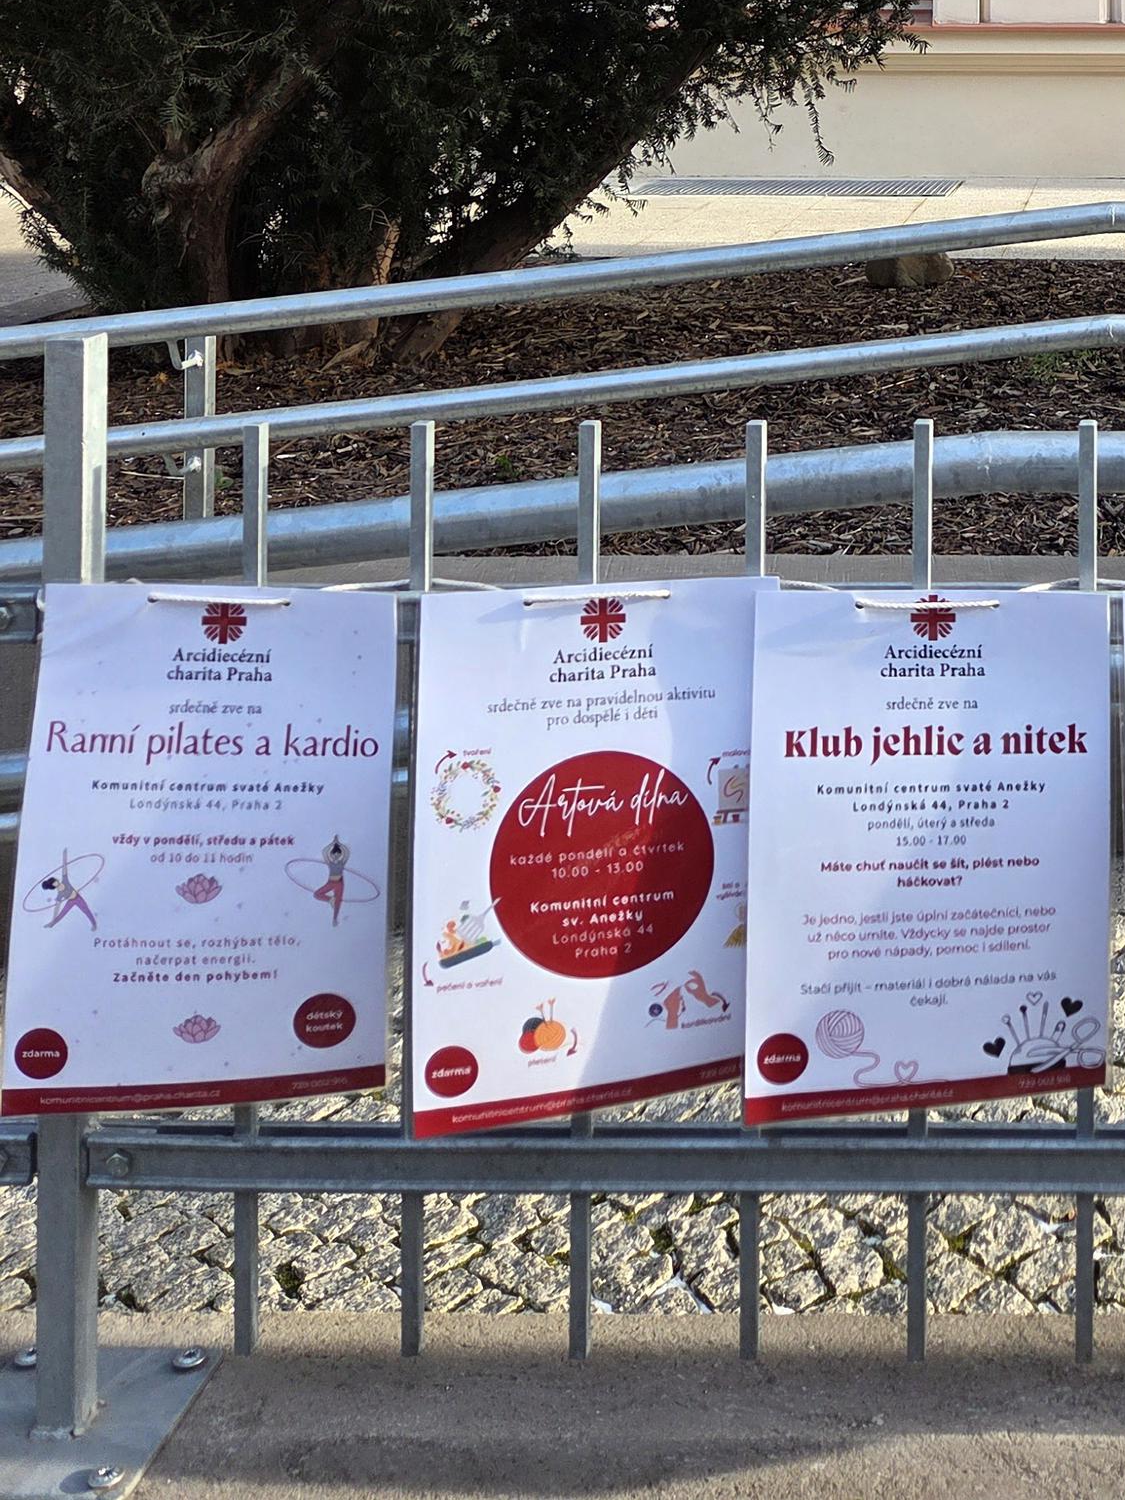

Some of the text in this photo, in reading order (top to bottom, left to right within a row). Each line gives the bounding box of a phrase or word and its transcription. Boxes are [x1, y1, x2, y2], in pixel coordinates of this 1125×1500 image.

[172, 647, 271, 664] Arcidiecézní
[553, 643, 653, 664] Arcidiecézní
[884, 643, 982, 659] Arcidiecézní
[166, 664, 272, 682] charita Praha
[549, 662, 656, 683] charita Praha
[880, 662, 985, 677] charita Praha
[168, 699, 262, 715] srdečně zve na
[487, 685, 716, 713] srdečně zve na pravidelnou aktivitu
[886, 695, 978, 710] srdečně zve na
[546, 715, 569, 731] pro
[572, 708, 621, 728] dospělé
[632, 705, 658, 721] děti
[46, 720, 379, 766] Ranní pilates a kardio
[784, 723, 1088, 766] Klub jehlic a nitek
[91, 779, 324, 795] Komunitní centrum svaté Anežky
[817, 780, 1045, 795] Komunitní centrum svaté Anežky
[517, 767, 690, 837] Artová dílna
[852, 798, 1009, 814] Londýnská 44, Praha 2
[867, 816, 914, 832] pondělí,
[917, 816, 947, 831] úterý
[959, 815, 995, 828] středa
[112, 833, 294, 848] vždy v pondělí, středu a pátek
[551, 865, 589, 879] 10.00
[606, 859, 644, 874] 13.00
[820, 855, 1040, 872] Máte chuť naučit se šít, plést nebo
[896, 875, 963, 887] háčkovat?
[530, 890, 674, 913] Komunitní centrum
[562, 908, 643, 927] sv. Anežky
[552, 923, 653, 945] Londýnská 44
[575, 945, 618, 958] Praha
[112, 969, 277, 984] Začněte den pohybem!
[22, 1049, 60, 1058] zdarma
